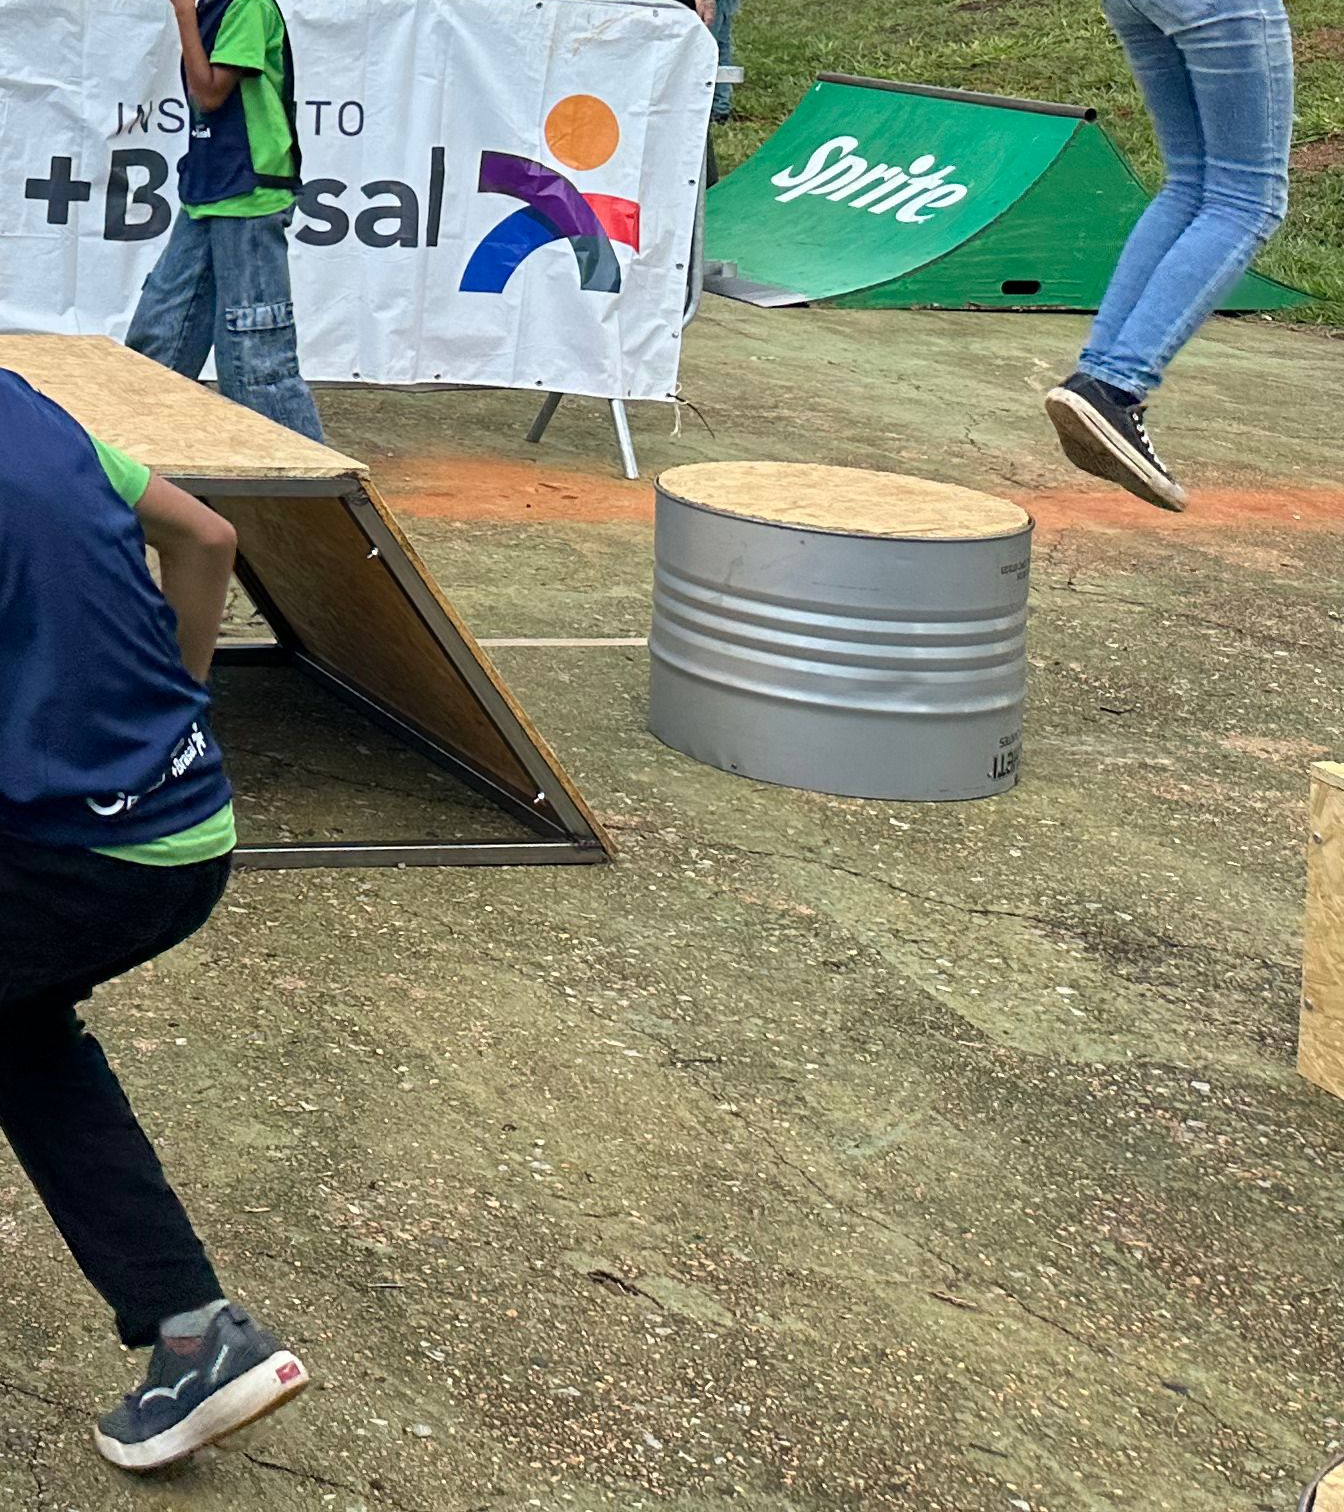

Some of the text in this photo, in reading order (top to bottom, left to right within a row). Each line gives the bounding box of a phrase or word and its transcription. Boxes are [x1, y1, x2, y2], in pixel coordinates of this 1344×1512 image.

[115, 97, 365, 137] INSTO
[25, 146, 445, 249] +Bsal
[771, 135, 968, 224] Sprite
